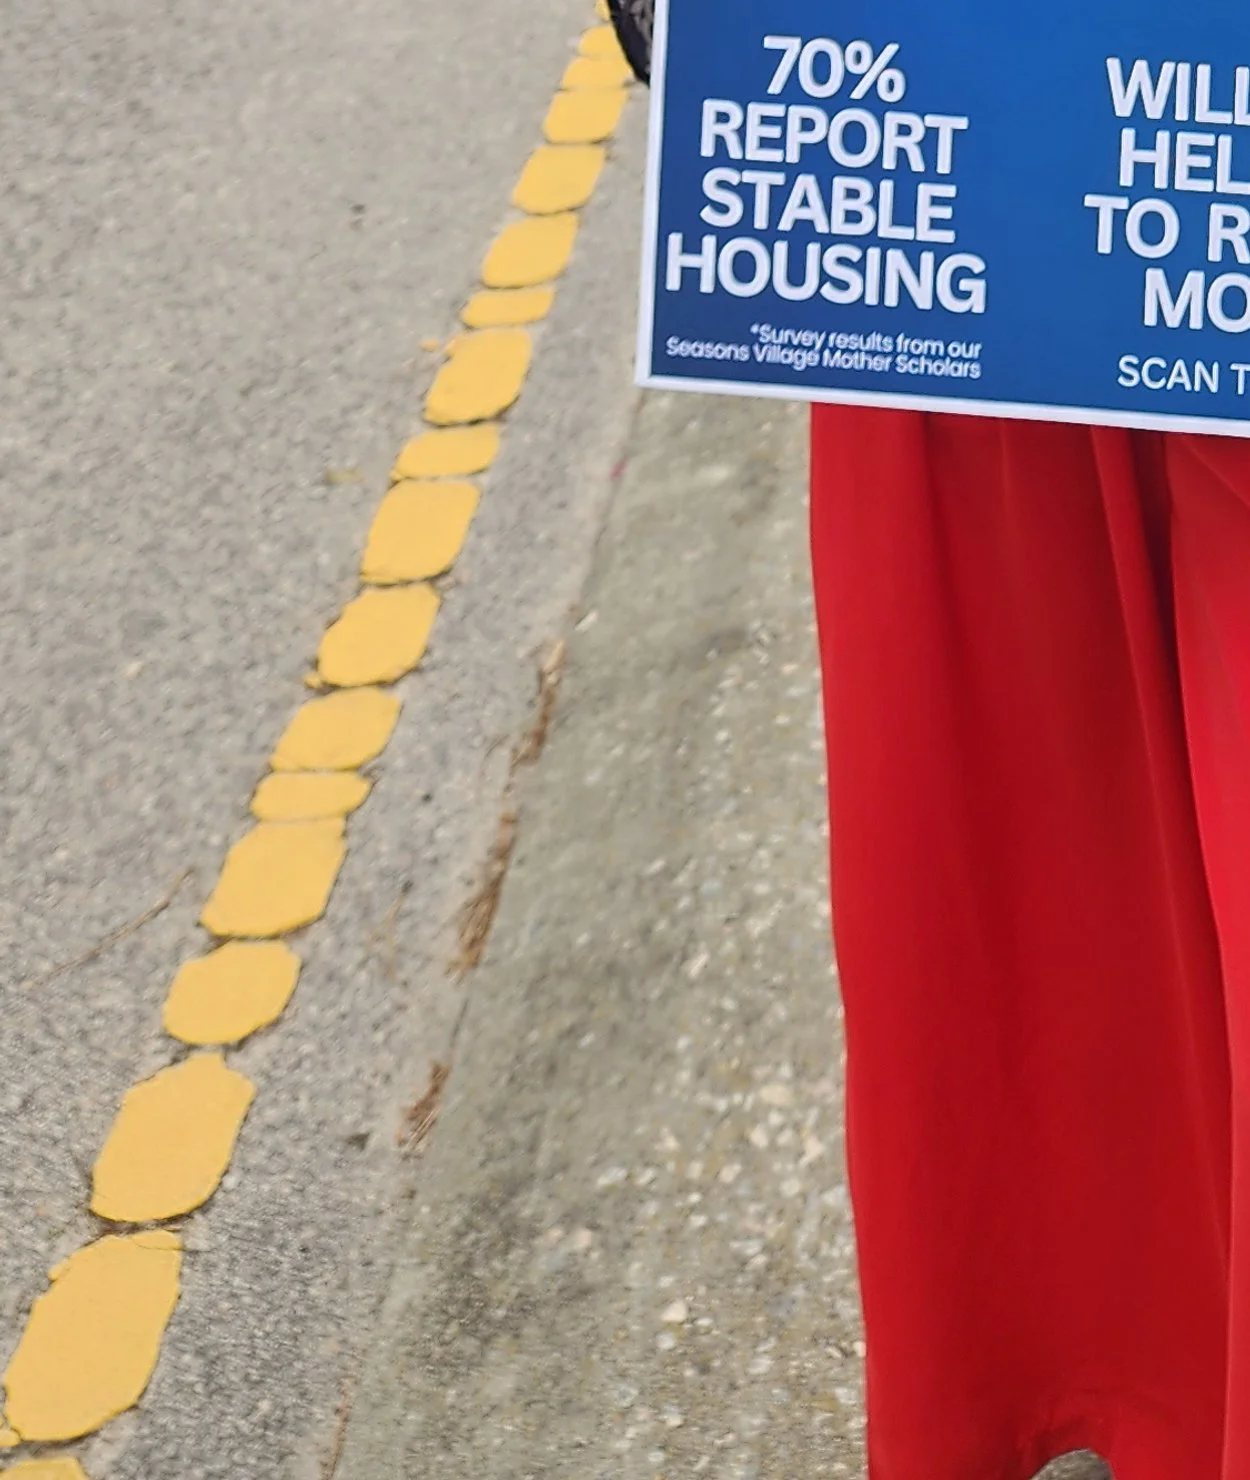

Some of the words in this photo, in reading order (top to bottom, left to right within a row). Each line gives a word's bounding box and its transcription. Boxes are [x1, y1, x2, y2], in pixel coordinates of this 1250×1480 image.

[763, 34, 906, 103] 70%
[699, 99, 969, 175] REPORT
[699, 168, 956, 245] STABLE
[1084, 194, 1180, 259] TO
[665, 233, 988, 314] HOUSING
[666, 336, 749, 362] Seasons
[753, 343, 818, 371] Village
[822, 349, 892, 372] Mother
[895, 354, 981, 379] Scholars
[829, 329, 893, 354] results
[896, 333, 944, 357] from
[947, 341, 982, 359] our
[1118, 354, 1222, 394] SCAN
